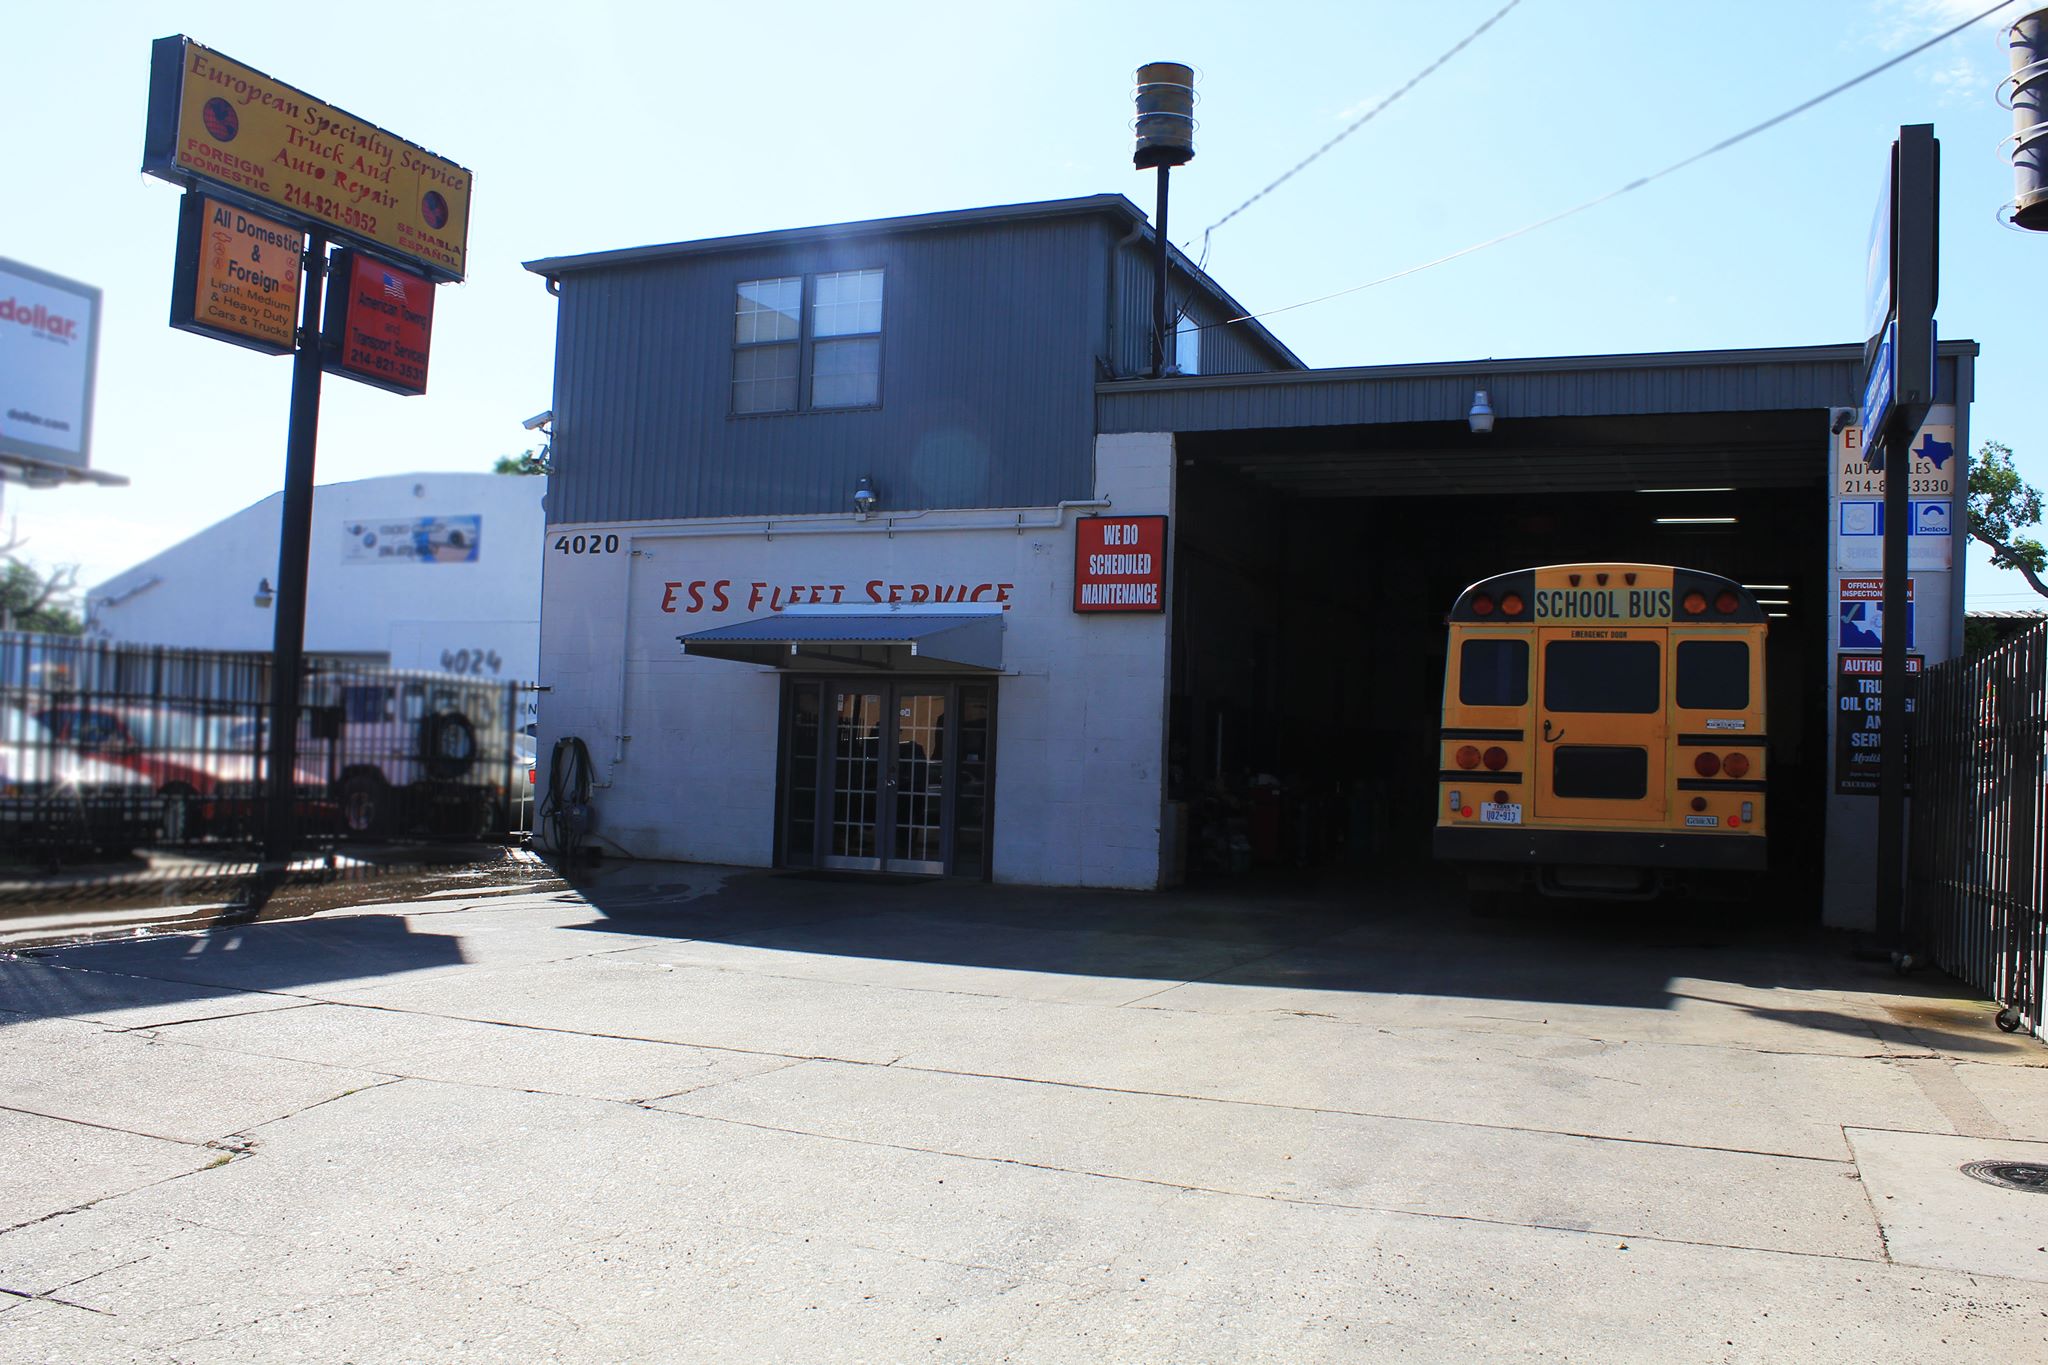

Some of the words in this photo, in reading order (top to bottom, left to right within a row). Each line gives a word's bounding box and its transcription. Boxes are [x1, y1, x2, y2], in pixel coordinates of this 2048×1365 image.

[192, 54, 299, 118] European
[304, 107, 393, 167] Specialty
[401, 151, 463, 190] Service
[188, 139, 265, 178] FOREIGN
[286, 125, 344, 164] Truck
[350, 155, 396, 184] And
[181, 152, 270, 192] DOMESTIC
[272, 148, 325, 180] Auto
[333, 169, 398, 209] Repair
[213, 208, 231, 229] All
[236, 215, 300, 254] Domestic
[398, 222, 413, 236] SE
[416, 231, 461, 256] HABLA
[251, 244, 261, 263] &
[228, 259, 279, 293] Foreign
[210, 292, 219, 303] &
[224, 296, 260, 316] Heavy
[263, 309, 289, 327] Duty
[247, 290, 290, 312] Medium
[208, 305, 236, 321] Cars
[239, 315, 248, 325] &
[252, 318, 289, 338] Trucks
[1845, 480, 1949, 493] 214-8-3330
[555, 534, 619, 555] 4020
[1104, 525, 1120, 545] WE
[1123, 524, 1139, 545] DO
[1089, 553, 1151, 575] SCHEDULED
[661, 580, 730, 613] ESS
[1081, 583, 1157, 604] MAINTENANCE
[1536, 591, 1620, 618] SCHOOL
[1629, 590, 1671, 618] BUS
[1611, 631, 1627, 639] DOOR
[440, 649, 502, 675] 4024
[1841, 697, 1861, 711] OIL
